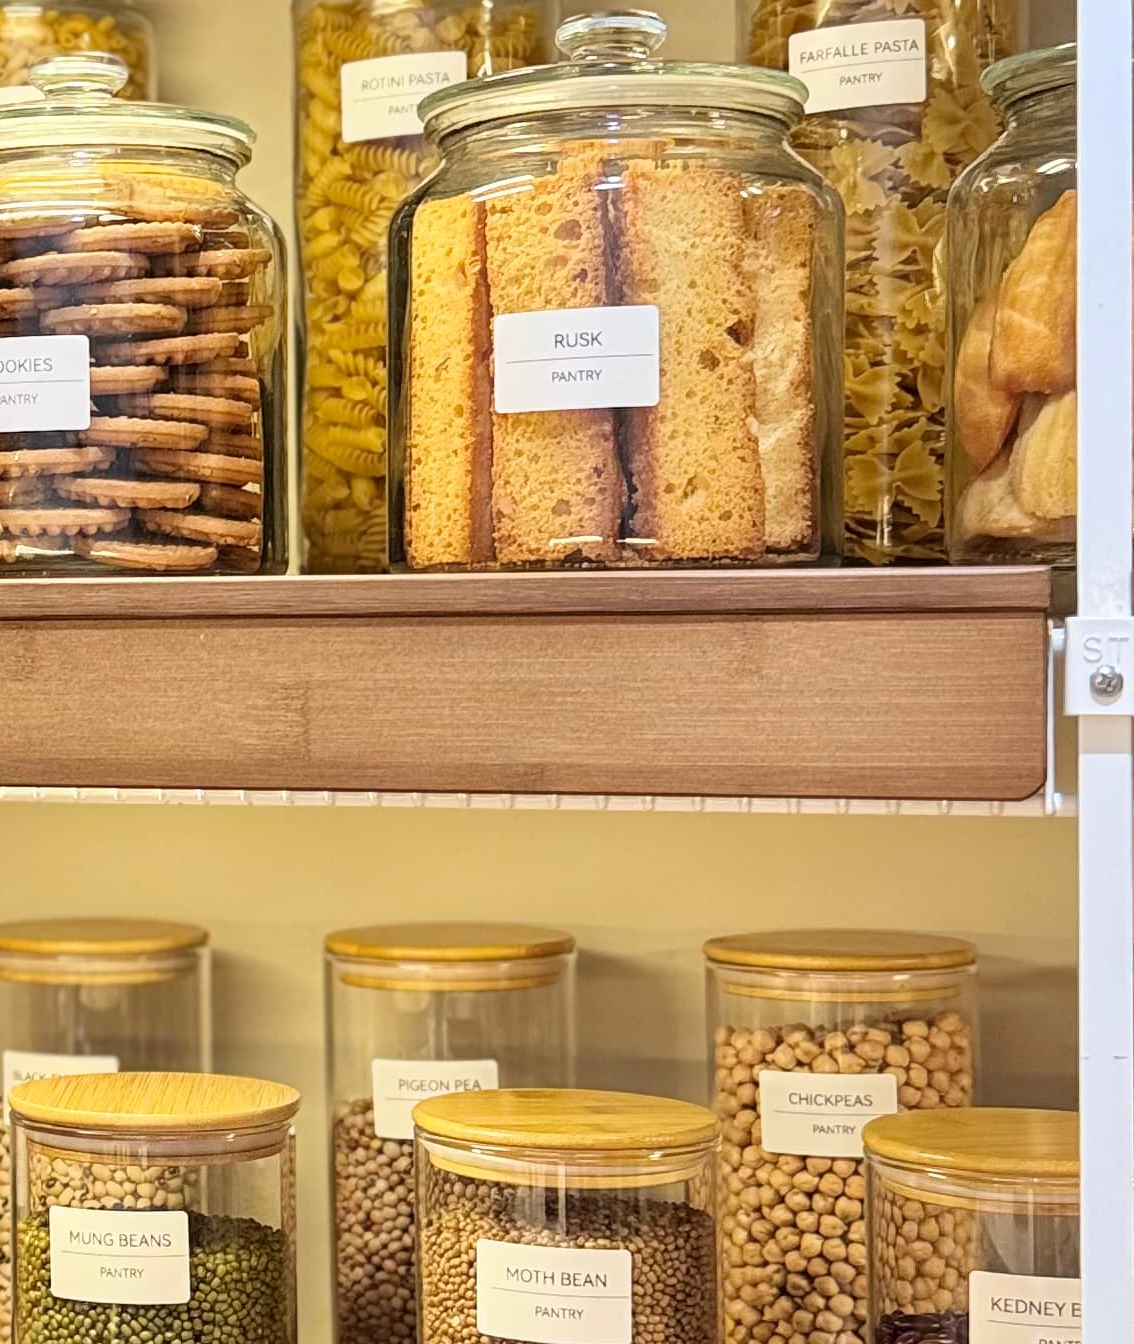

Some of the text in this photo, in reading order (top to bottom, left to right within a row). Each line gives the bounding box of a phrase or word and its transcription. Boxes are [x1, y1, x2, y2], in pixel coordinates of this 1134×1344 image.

[799, 39, 920, 65] FARFALLE PASTA
[361, 71, 451, 92] ROTINI PASTA
[839, 72, 883, 86] PANTRY
[388, 103, 417, 116] PANT
[554, 330, 603, 349] RUSK
[551, 368, 603, 384] PANTRY
[1083, 636, 1130, 664] ST
[398, 1078, 482, 1092] PIGEON PEA
[787, 1091, 874, 1108] CHICKPEAS
[812, 1123, 856, 1136] PANTRY
[68, 1229, 172, 1248] MUNG BEANS
[99, 1266, 145, 1280] PANTRY
[505, 1266, 608, 1289] MOTH BEAN
[534, 1305, 584, 1321] PANTRY
[990, 1296, 1066, 1318] KEDNEY
